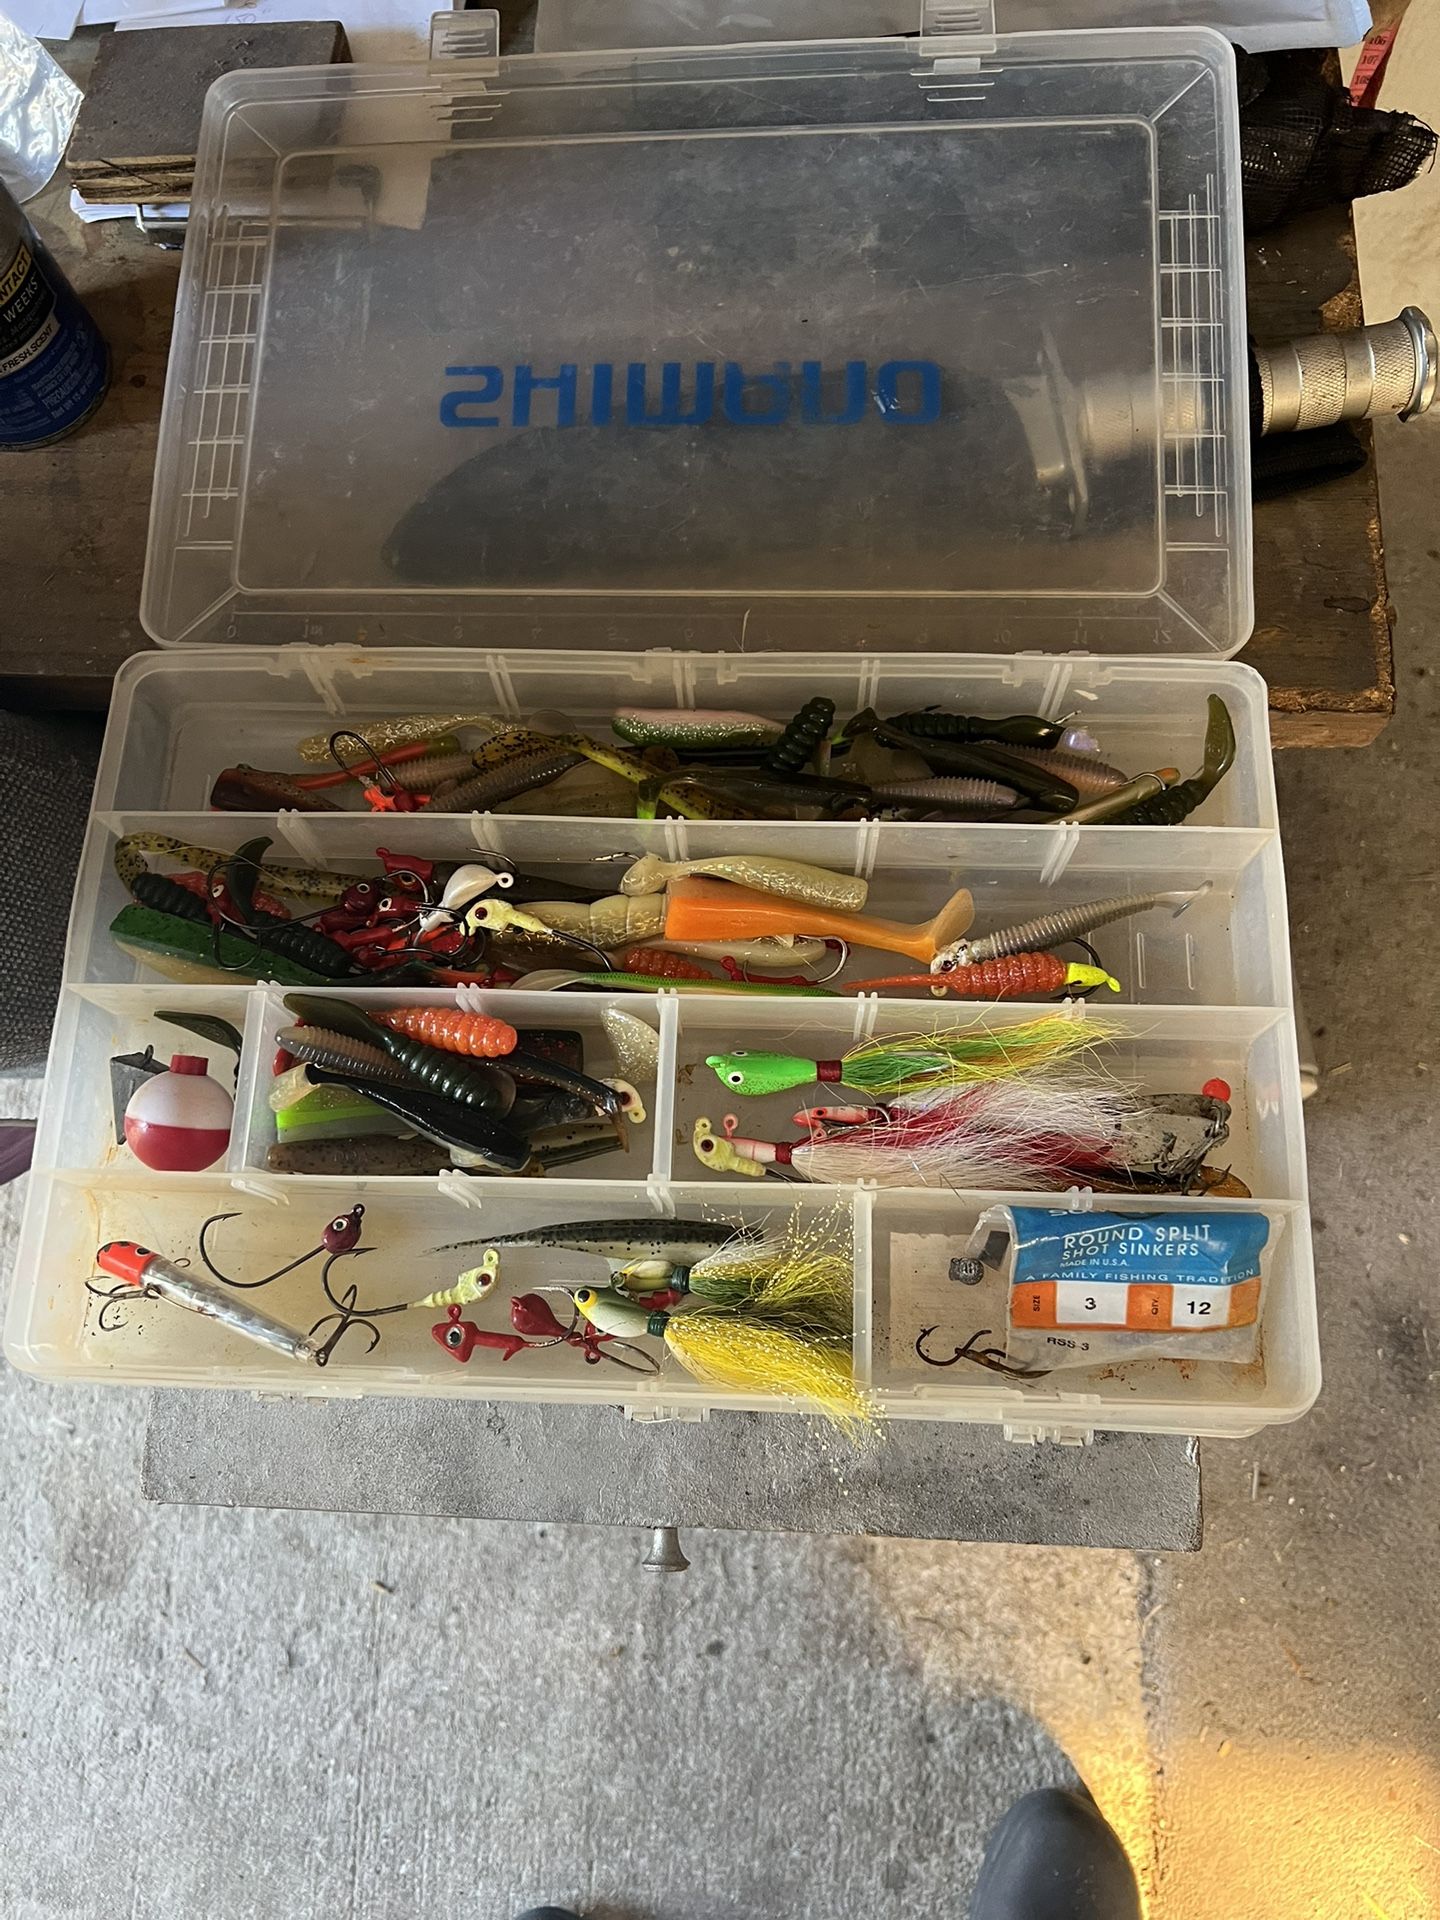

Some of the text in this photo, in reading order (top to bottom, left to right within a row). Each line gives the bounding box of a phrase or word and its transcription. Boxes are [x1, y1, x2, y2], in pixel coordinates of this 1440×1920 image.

[1361, 55, 1379, 65] 107
[1064, 1223, 1211, 1250] ROUND SPLIT
[1062, 1242, 1200, 1260] SHOT SINKERS
[1060, 1258, 1130, 1268] MADE IN U.S.A.
[1042, 1271, 1099, 1280] FAMILY
[1105, 1272, 1169, 1281] FISHING
[1175, 1268, 1254, 1285] TRADITION
[1084, 1297, 1097, 1310] 3
[1186, 1301, 1212, 1315] 12
